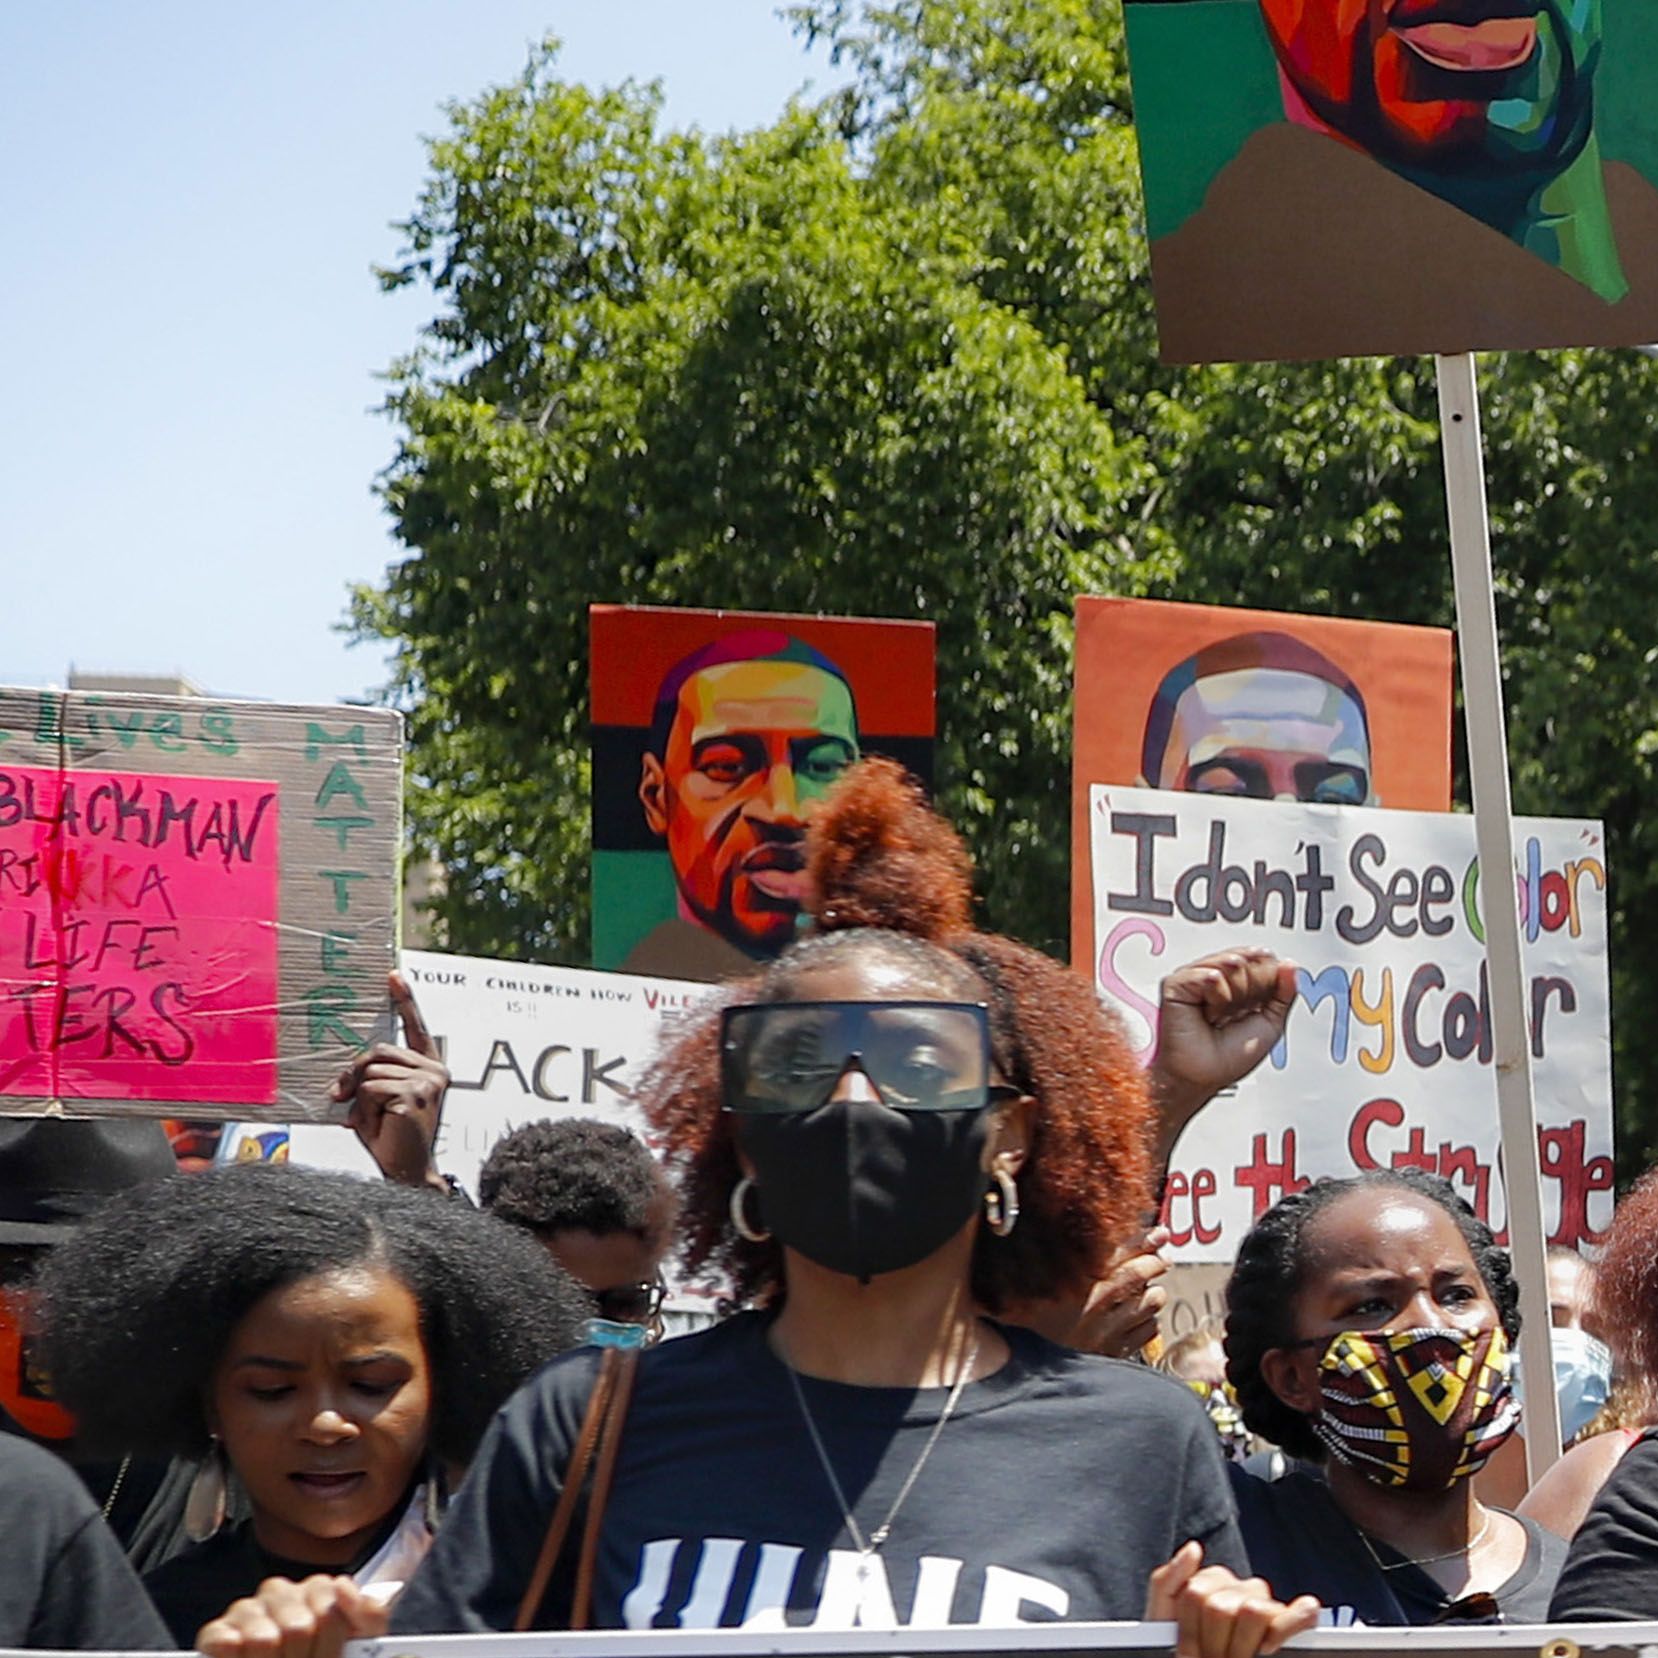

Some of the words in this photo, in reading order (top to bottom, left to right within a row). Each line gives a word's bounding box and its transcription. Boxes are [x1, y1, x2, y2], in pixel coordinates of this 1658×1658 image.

[1174, 821, 1335, 931] don't
[1336, 833, 1454, 945] See
[24, 910, 180, 971] LIFE
[409, 968, 467, 987] YOUR
[431, 1035, 632, 1104] LACK
